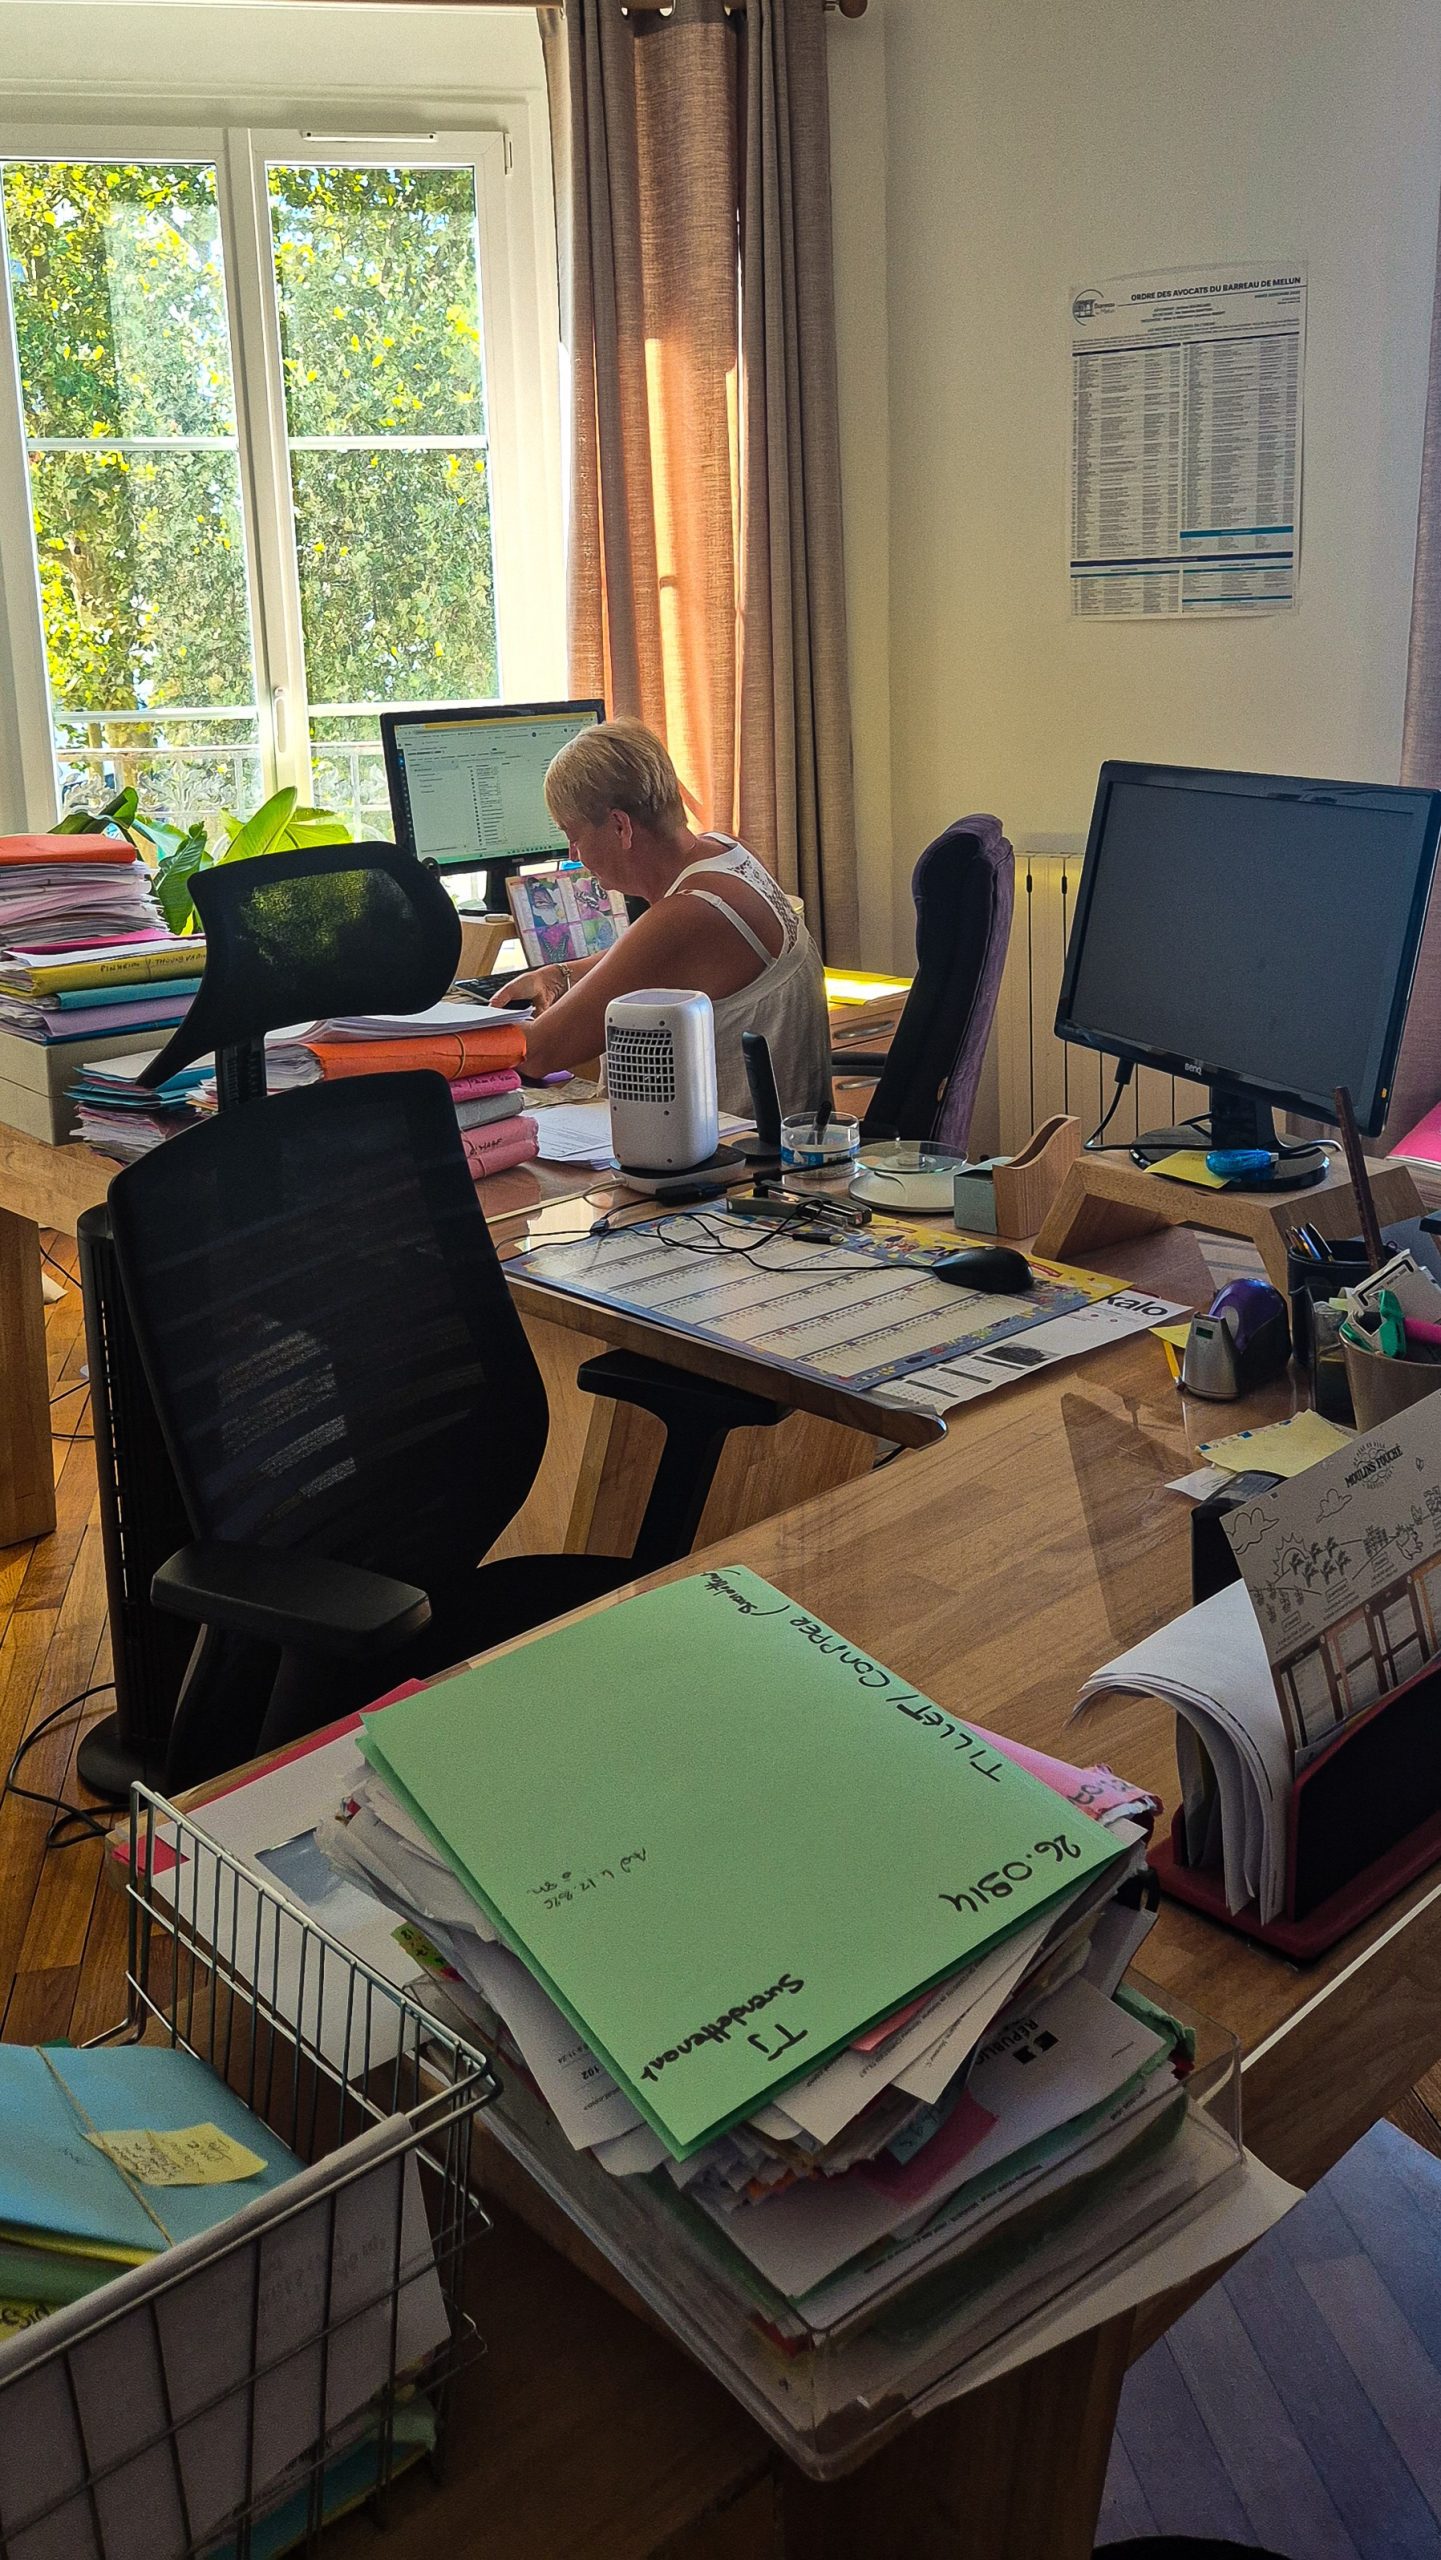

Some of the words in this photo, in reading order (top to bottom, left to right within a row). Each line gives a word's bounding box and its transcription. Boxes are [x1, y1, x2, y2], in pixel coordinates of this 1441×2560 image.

[1131, 292, 1155, 301] ORDRE
[1157, 289, 1172, 299] DES
[1173, 286, 1208, 298] AVOCATS
[1209, 284, 1221, 292] DU
[1222, 280, 1259, 291] BARREAU
[1272, 276, 1301, 286] MELUN
[1344, 1460, 1377, 1488] MOULINS
[747, 2023, 808, 2062] TJ
[581, 2065, 600, 2080] 102
